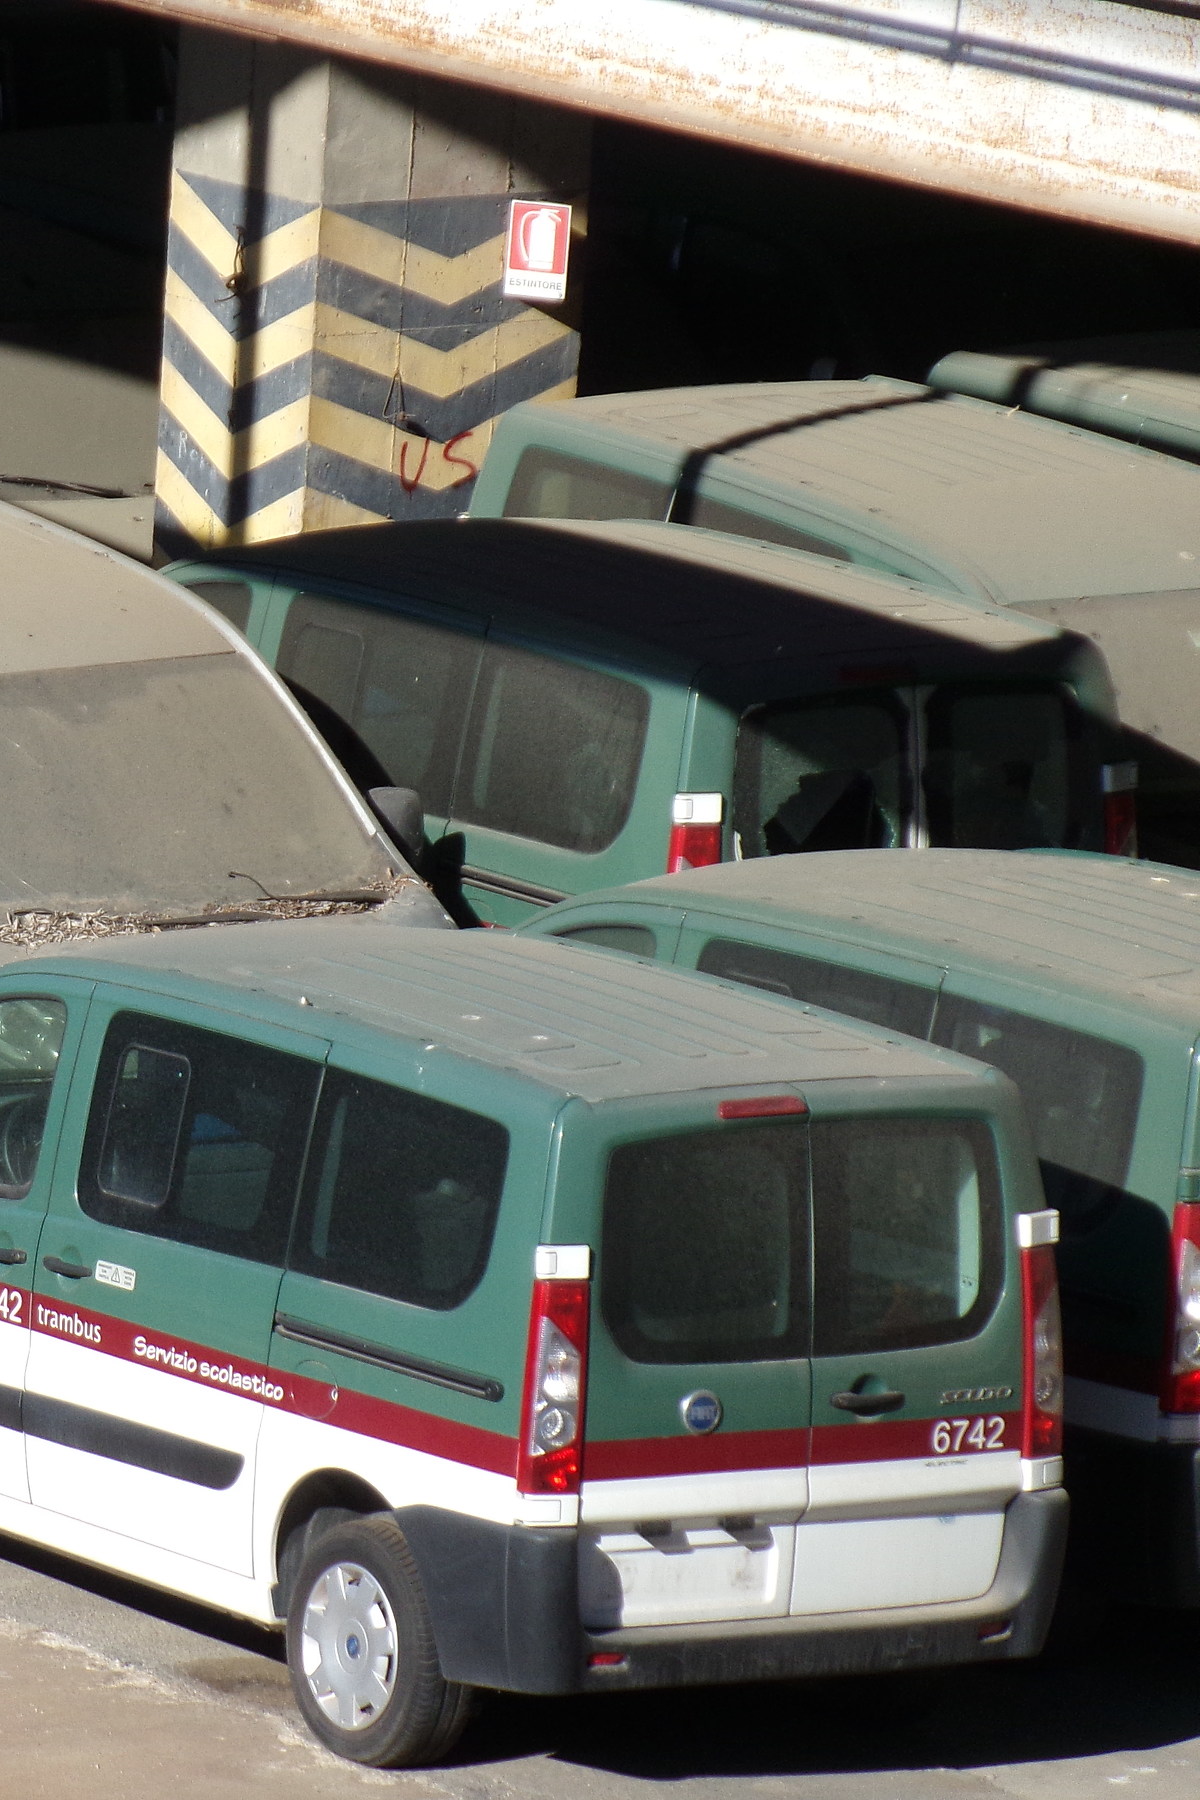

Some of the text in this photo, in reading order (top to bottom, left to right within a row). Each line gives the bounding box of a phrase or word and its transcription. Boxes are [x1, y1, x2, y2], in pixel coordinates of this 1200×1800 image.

[509, 277, 563, 291] ESTINTORE
[37, 1303, 102, 1343] trambus
[134, 1335, 284, 1401] Servizio scolastico
[932, 1416, 1006, 1454] 6742
